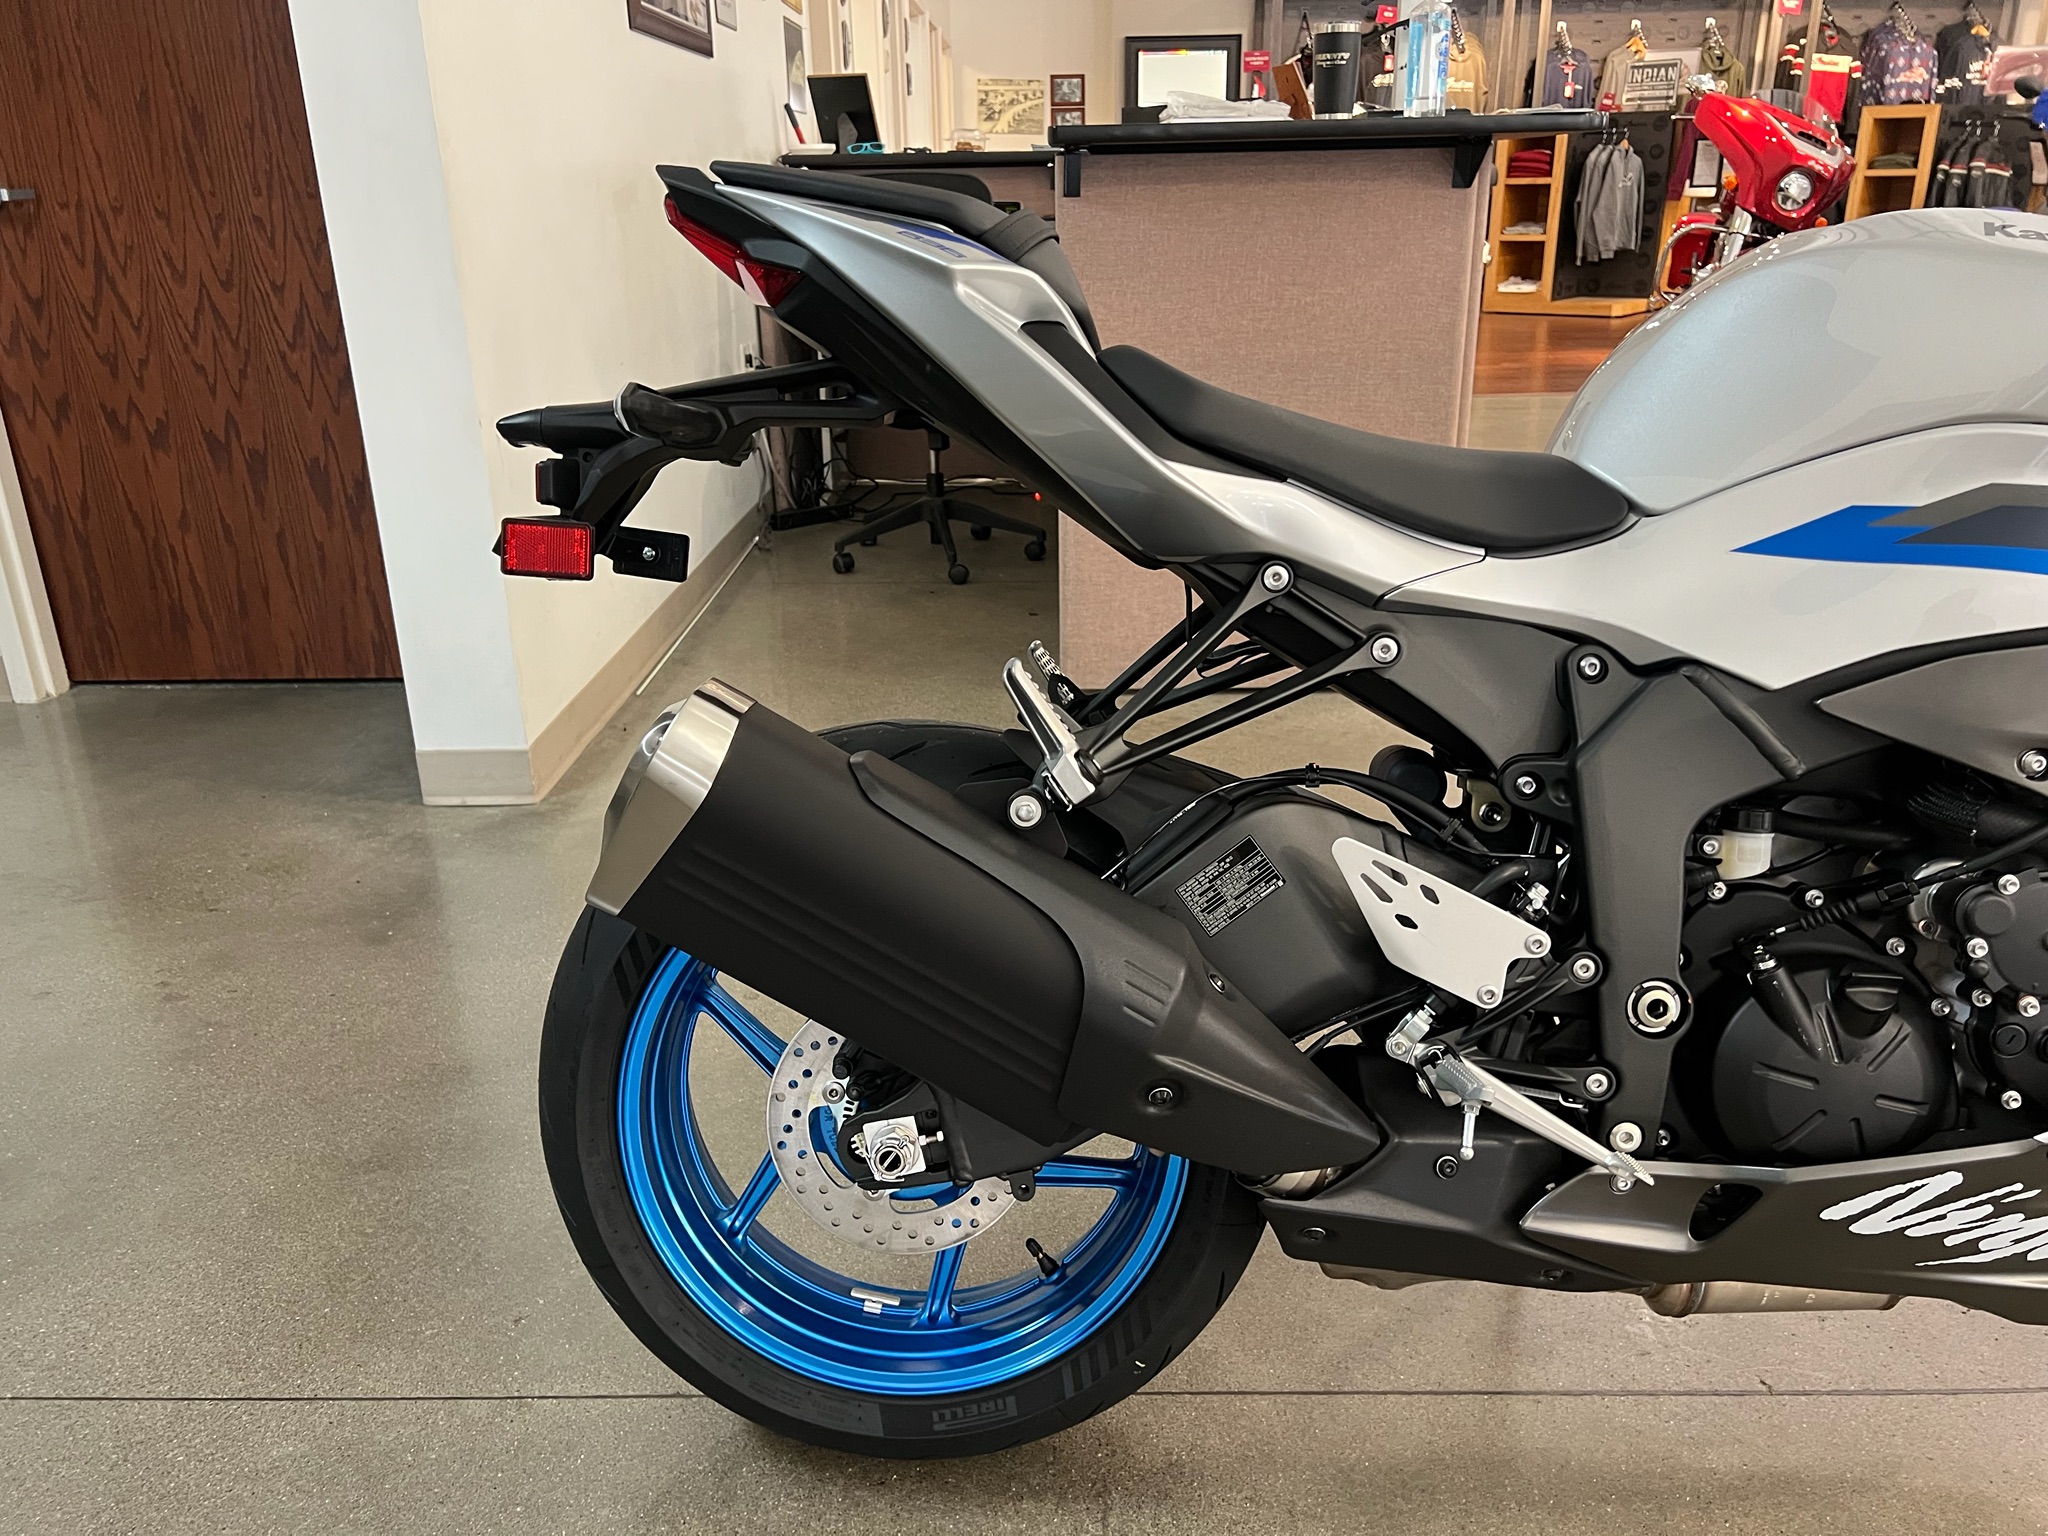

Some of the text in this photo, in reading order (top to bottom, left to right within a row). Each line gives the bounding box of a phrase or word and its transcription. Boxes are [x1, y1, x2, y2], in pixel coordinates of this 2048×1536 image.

[1628, 66, 1677, 84] INDIAN
[1983, 221, 2048, 241] Ka
[1819, 1171, 2048, 1266] Ninj
[931, 1395, 1019, 1432] PIRELLI
